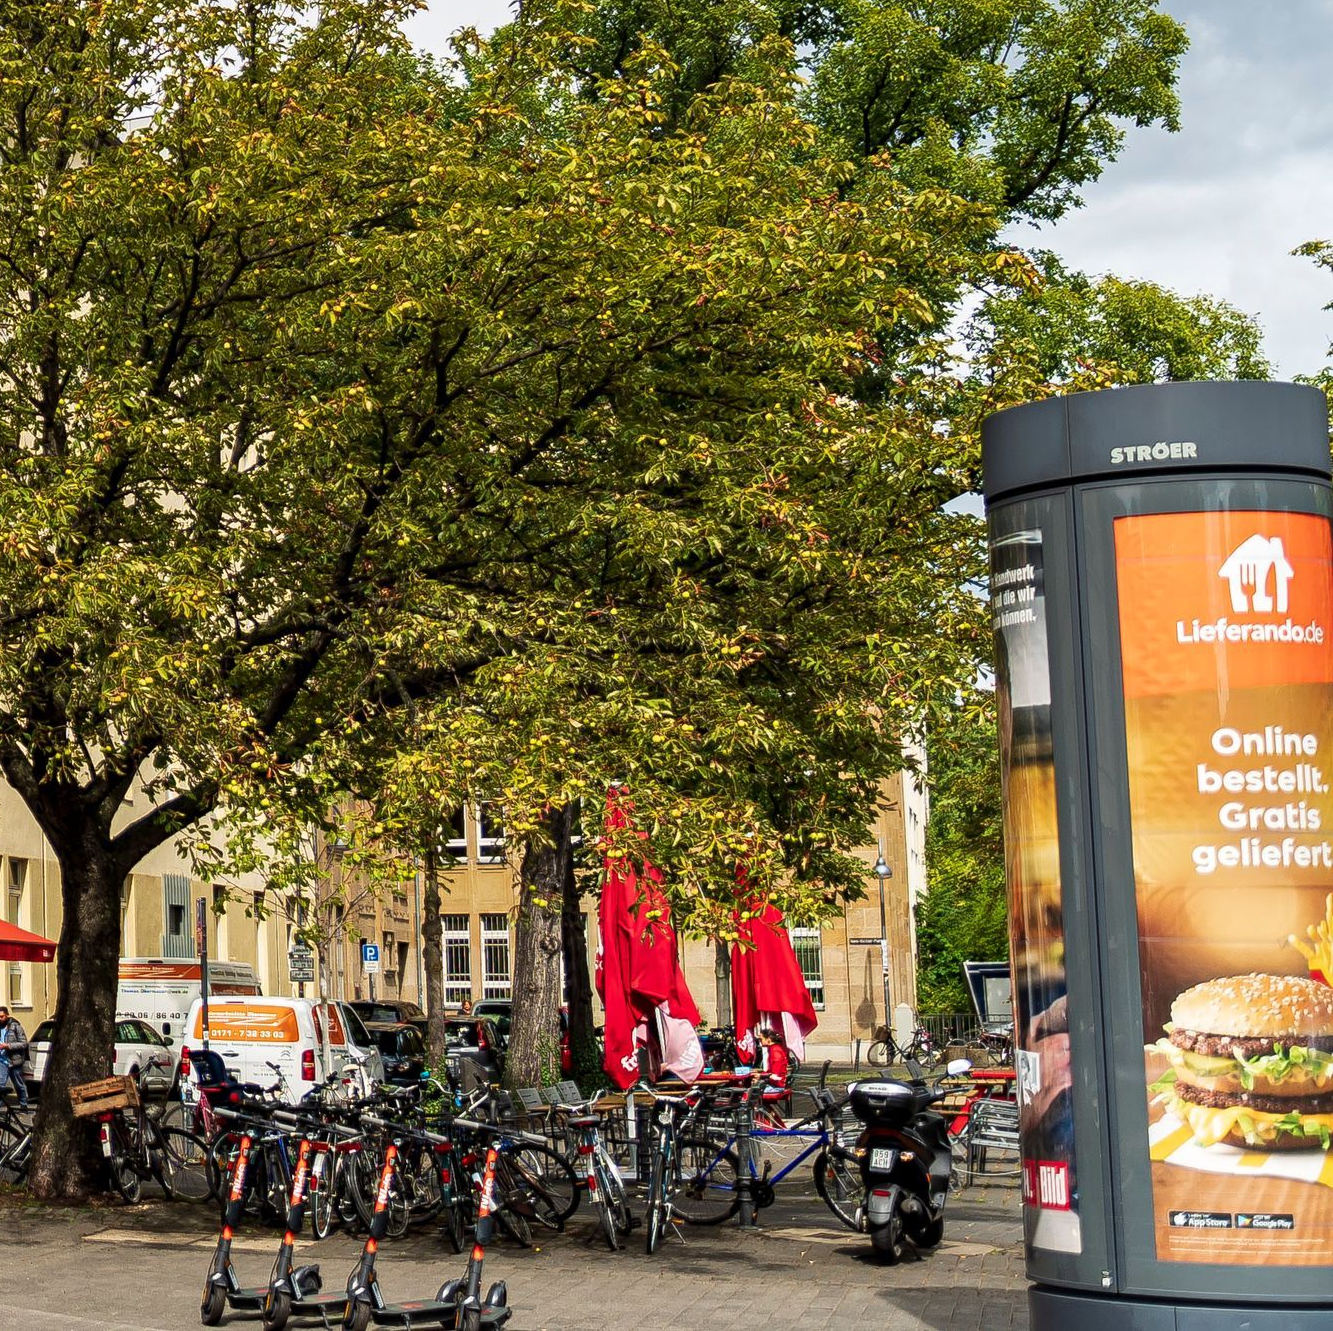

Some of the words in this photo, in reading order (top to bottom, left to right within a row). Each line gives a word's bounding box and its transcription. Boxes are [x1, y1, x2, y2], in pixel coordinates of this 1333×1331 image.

[1110, 441, 1197, 464] STRÖER
[1003, 590, 1016, 606] die
[1017, 584, 1036, 602] wir
[1001, 608, 1037, 628] können.
[1177, 618, 1324, 644] Lieferando.de
[1211, 725, 1318, 756] Online
[1197, 761, 1329, 794] bestellt.
[1218, 801, 1322, 831] Gratis
[156, 1011, 167, 1019] 86
[170, 1011, 181, 1019] 40
[211, 1029, 232, 1037] 0171
[1040, 1166, 1067, 1206] Bild
[1188, 1218, 1207, 1228] App
[1207, 1218, 1228, 1227] Store
[1252, 1219, 1276, 1228] Google
[1277, 1220, 1292, 1228] Play
